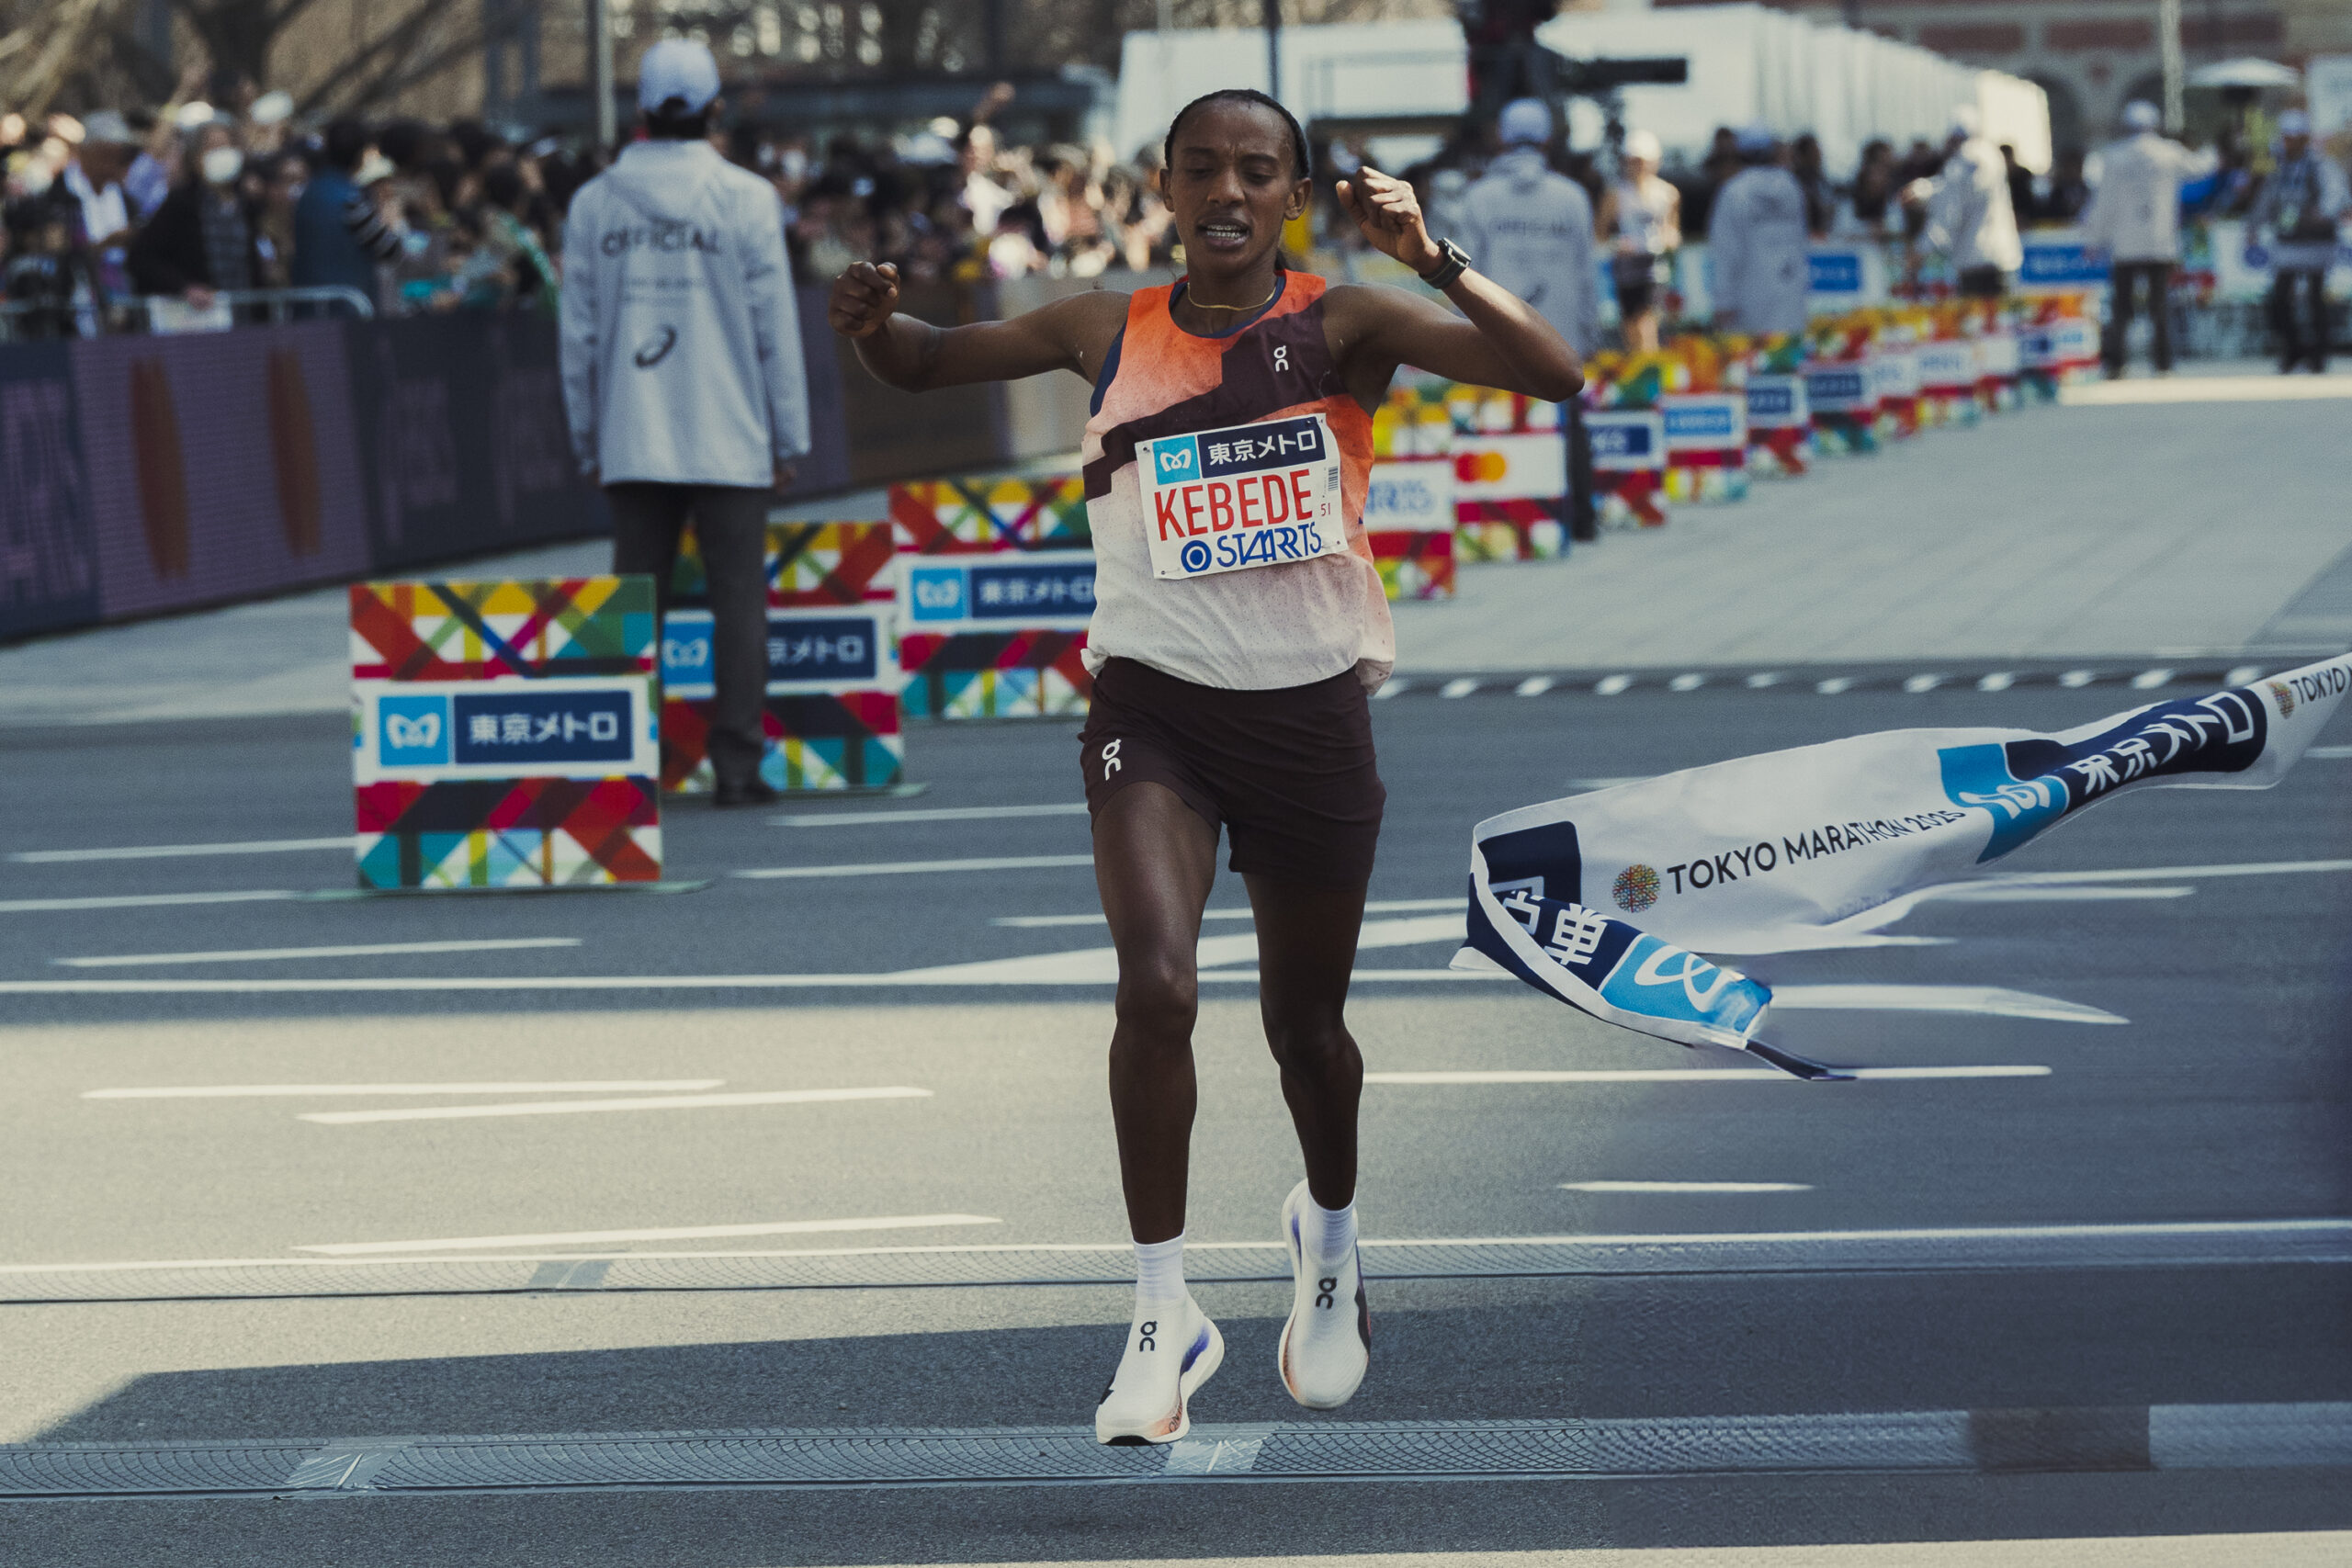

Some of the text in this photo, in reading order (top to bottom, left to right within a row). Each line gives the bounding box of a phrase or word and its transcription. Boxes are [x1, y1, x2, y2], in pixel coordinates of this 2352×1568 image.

[1207, 429, 1317, 466] 東京メトロ
[1154, 468, 1313, 542] KEBEDE
[1320, 502, 1331, 516] 51
[468, 710, 618, 746] 東京メトロ
[1667, 809, 1966, 895] TOKYO MARATHON 2025
